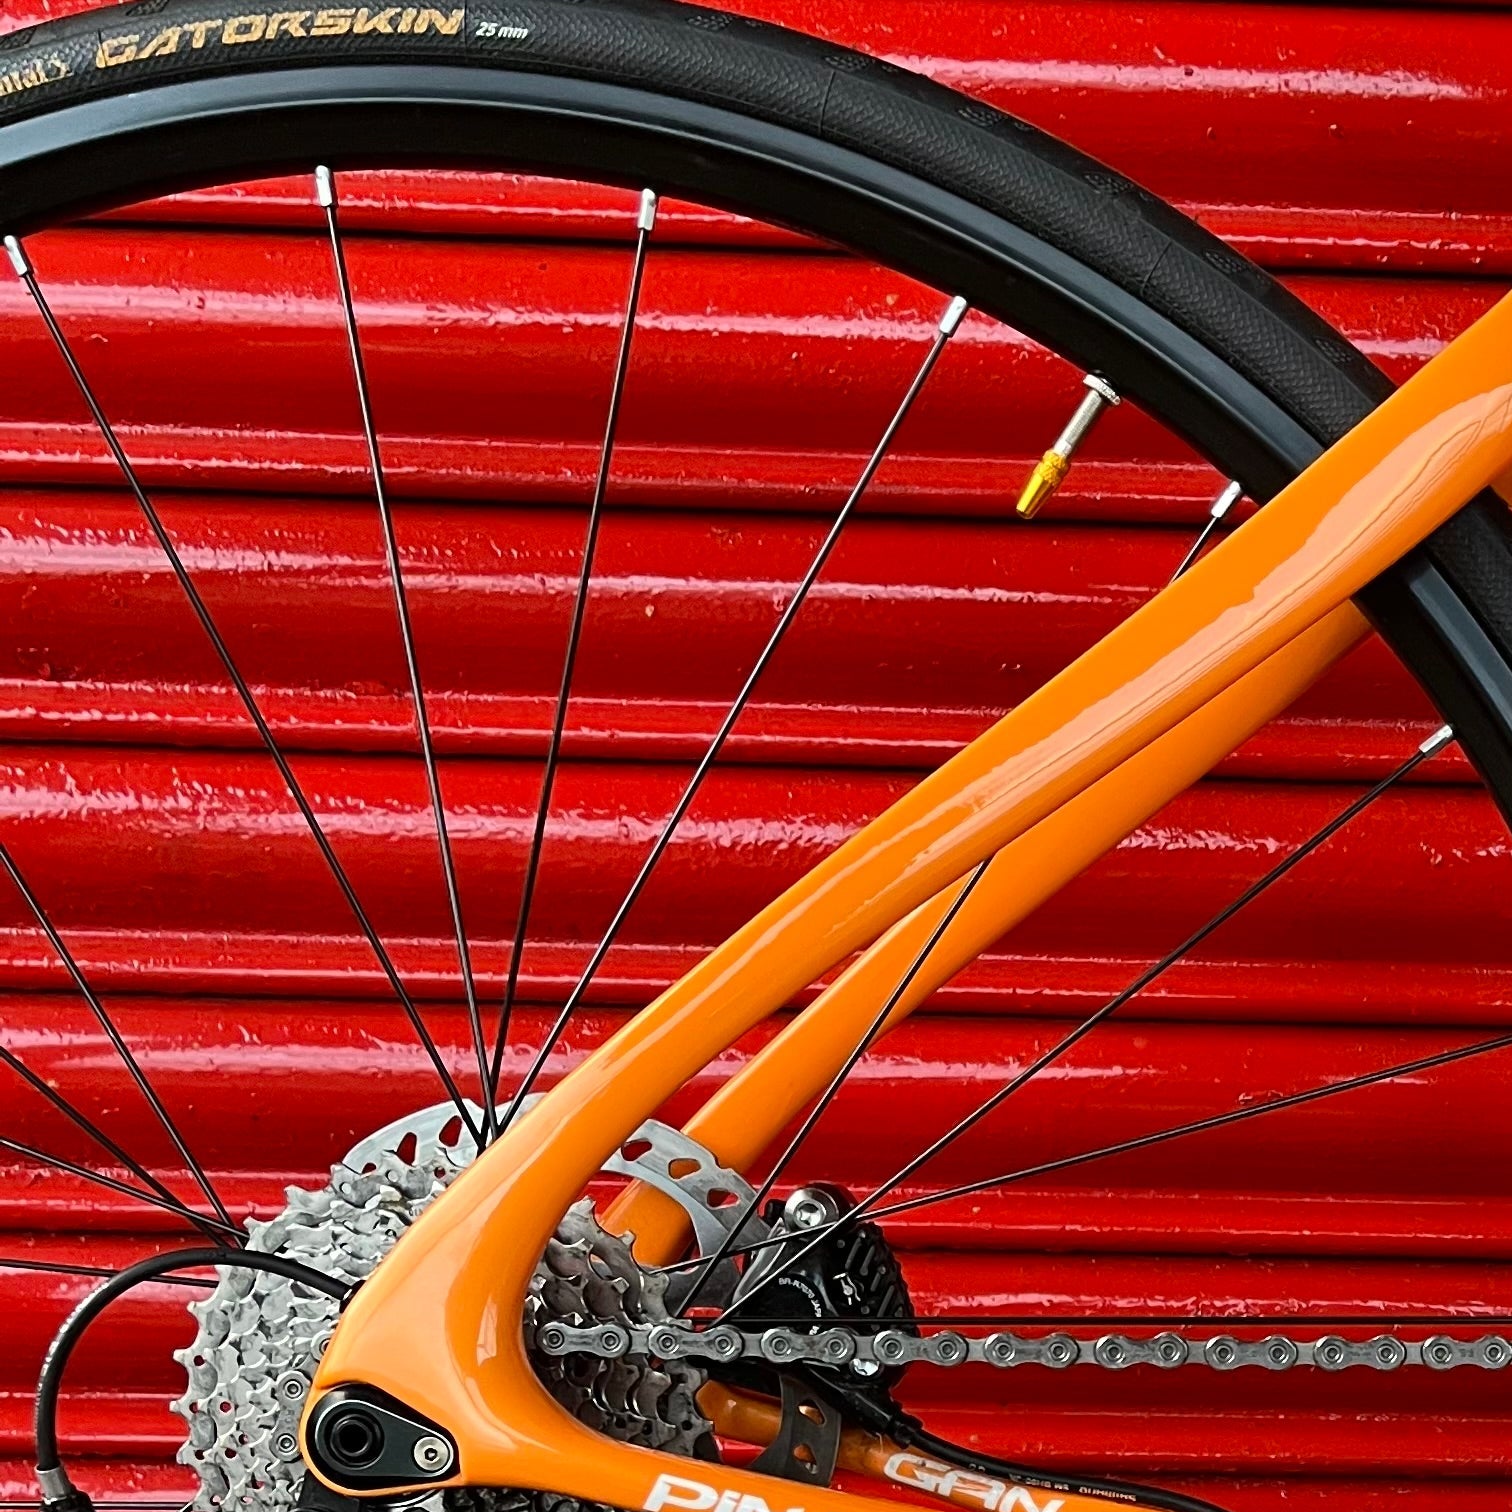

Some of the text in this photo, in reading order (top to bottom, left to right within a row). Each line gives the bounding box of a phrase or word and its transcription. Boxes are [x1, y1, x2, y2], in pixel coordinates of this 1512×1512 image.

[95, 7, 465, 69] GATORSKIN
[475, 21, 528, 40] 25 mm
